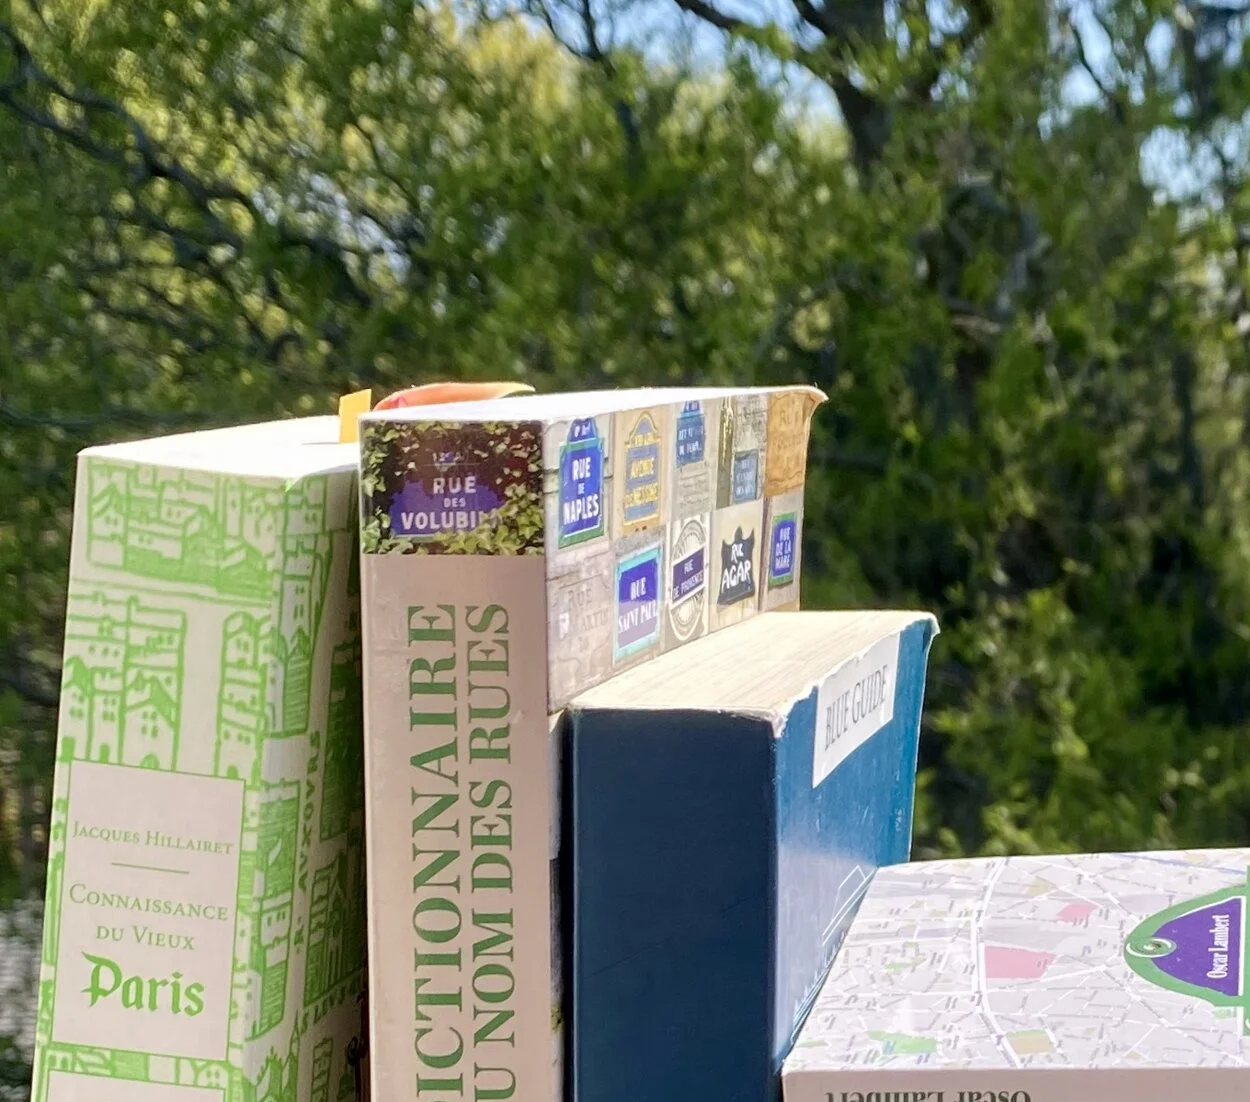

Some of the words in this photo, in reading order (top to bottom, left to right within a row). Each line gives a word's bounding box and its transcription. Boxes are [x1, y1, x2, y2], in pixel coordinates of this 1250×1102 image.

[572, 457, 591, 480] RUE
[433, 476, 477, 494] RUE
[578, 482, 585, 495] DE
[444, 498, 466, 508] DES
[563, 494, 599, 525] NAPLES
[780, 527, 791, 542] RUE
[684, 559, 694, 575] RUE
[731, 543, 744, 563] RUE
[630, 577, 646, 600] RUE
[721, 560, 751, 593] AGAR
[619, 608, 638, 633] SAINT
[640, 600, 656, 623] PAUL
[465, 603, 512, 765] RUES
[825, 689, 850, 751] BLUE
[851, 664, 887, 725] GUIDE
[469, 778, 514, 894] DES
[68, 883, 229, 922] CONNAISSANCE
[1208, 914, 1230, 952] Lambert
[471, 908, 516, 1049] NOM
[1206, 952, 1228, 979] Oscar
[80, 950, 205, 1017] Paris
